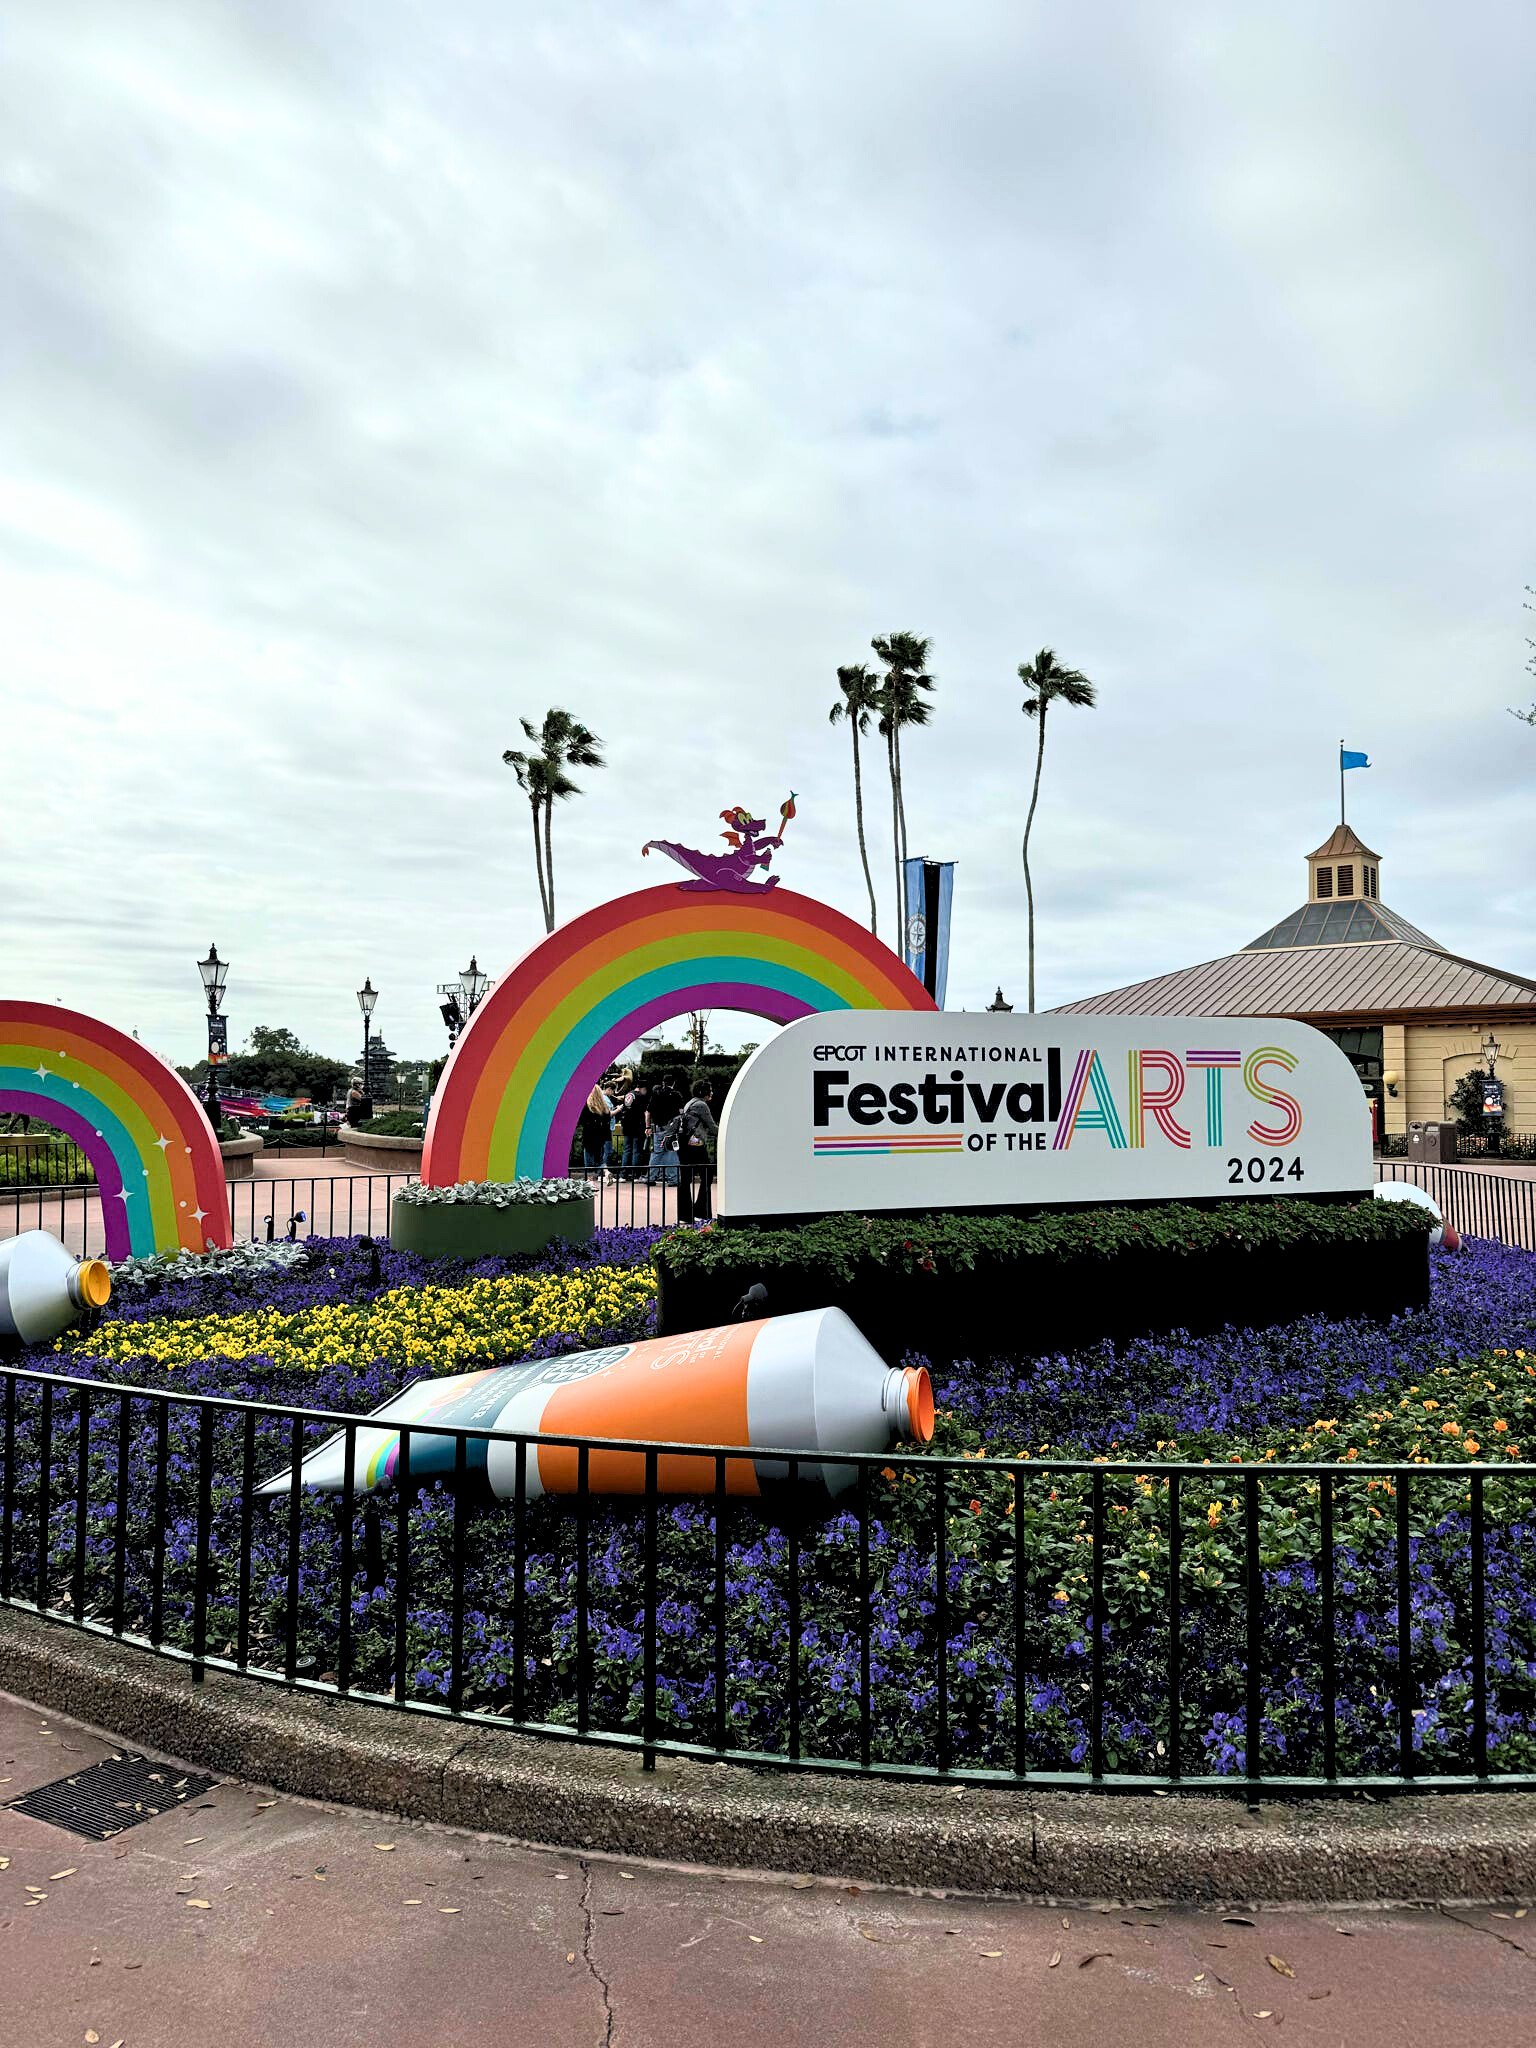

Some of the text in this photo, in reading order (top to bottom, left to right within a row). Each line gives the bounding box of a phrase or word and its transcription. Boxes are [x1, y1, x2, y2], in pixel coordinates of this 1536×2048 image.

[813, 1045, 1042, 1062] EPCOT INTERNATIONAL
[813, 1047, 1062, 1127] Festival
[1052, 1046, 1303, 1151] ARTS
[967, 1132, 1047, 1152] OF THE
[1227, 1156, 1305, 1184] 2024
